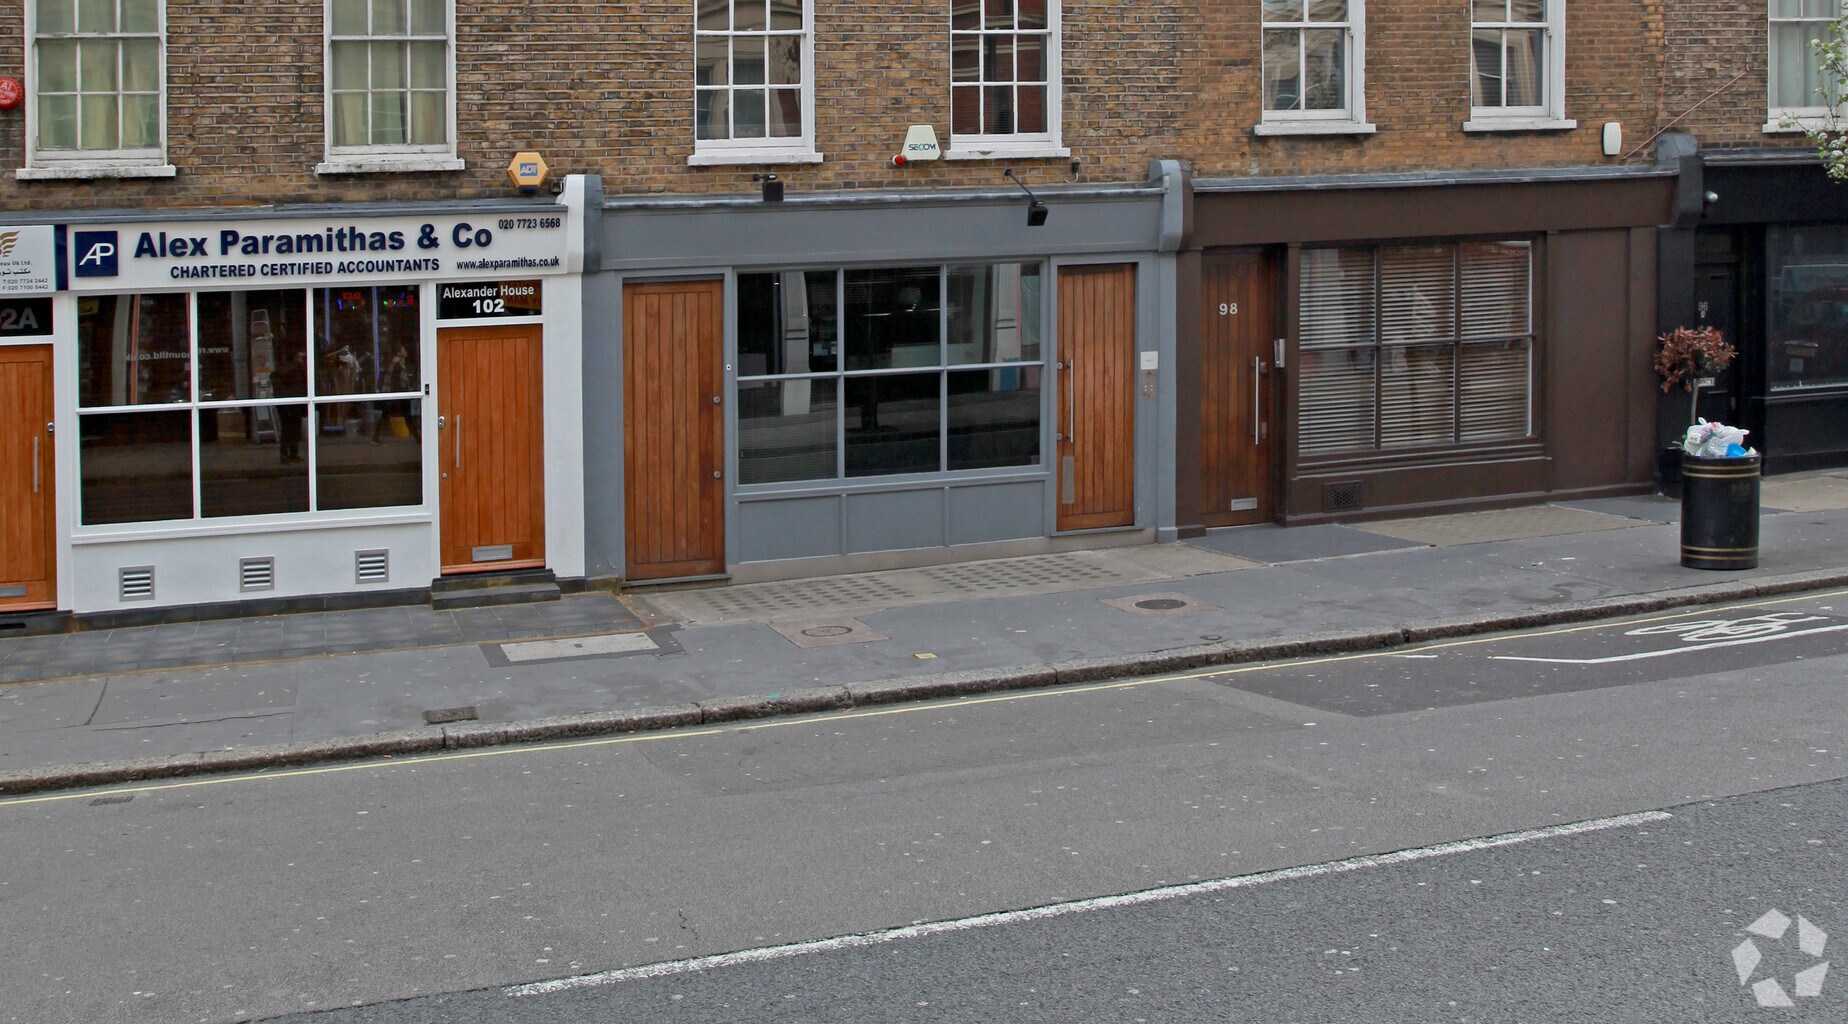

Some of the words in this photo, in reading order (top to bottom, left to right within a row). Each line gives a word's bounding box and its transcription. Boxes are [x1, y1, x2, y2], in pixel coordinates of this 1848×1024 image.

[908, 143, 936, 151] SECOM
[520, 164, 538, 174] ADT
[498, 219, 514, 230] 020
[517, 218, 537, 229] 7723
[540, 217, 561, 228] 6568
[134, 231, 208, 259] Alex
[220, 226, 405, 256] Paramithas
[417, 223, 440, 249] &
[452, 222, 493, 248] Co
[79, 242, 115, 266] AP
[170, 264, 256, 280] CHARTERED
[260, 261, 333, 276] CERTIFIED
[337, 258, 440, 274] ACCOUNTANTS
[456, 256, 560, 271] www.alexparamithas.co.uk
[443, 285, 498, 299] Alexander
[500, 284, 535, 296] House
[472, 298, 505, 314] 102
[1219, 303, 1238, 315] 98
